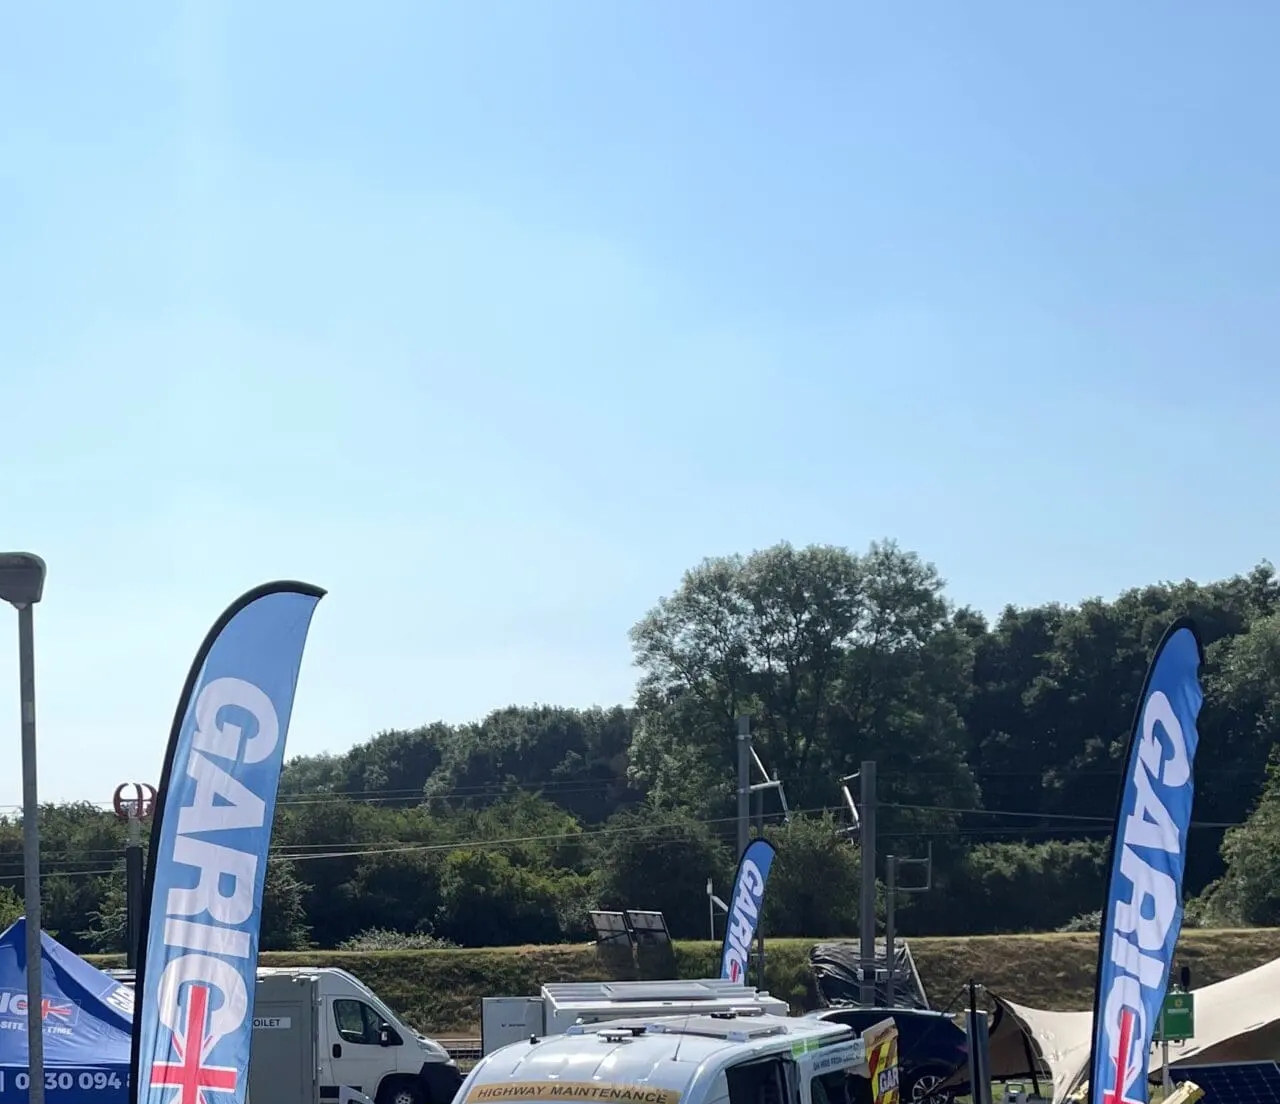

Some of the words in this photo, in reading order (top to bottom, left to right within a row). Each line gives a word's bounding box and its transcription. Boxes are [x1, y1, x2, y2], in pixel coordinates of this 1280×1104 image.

[157, 677, 279, 1036] GARIC
[1104, 690, 1190, 1082] GARIC
[725, 859, 764, 985] GARIC
[253, 1018, 281, 1027] OILET
[15, 1073, 73, 1090] 030
[78, 1072, 121, 1090] 094
[477, 1086, 546, 1098] HIGHWAY
[550, 1086, 668, 1104] MAINTENANCE
